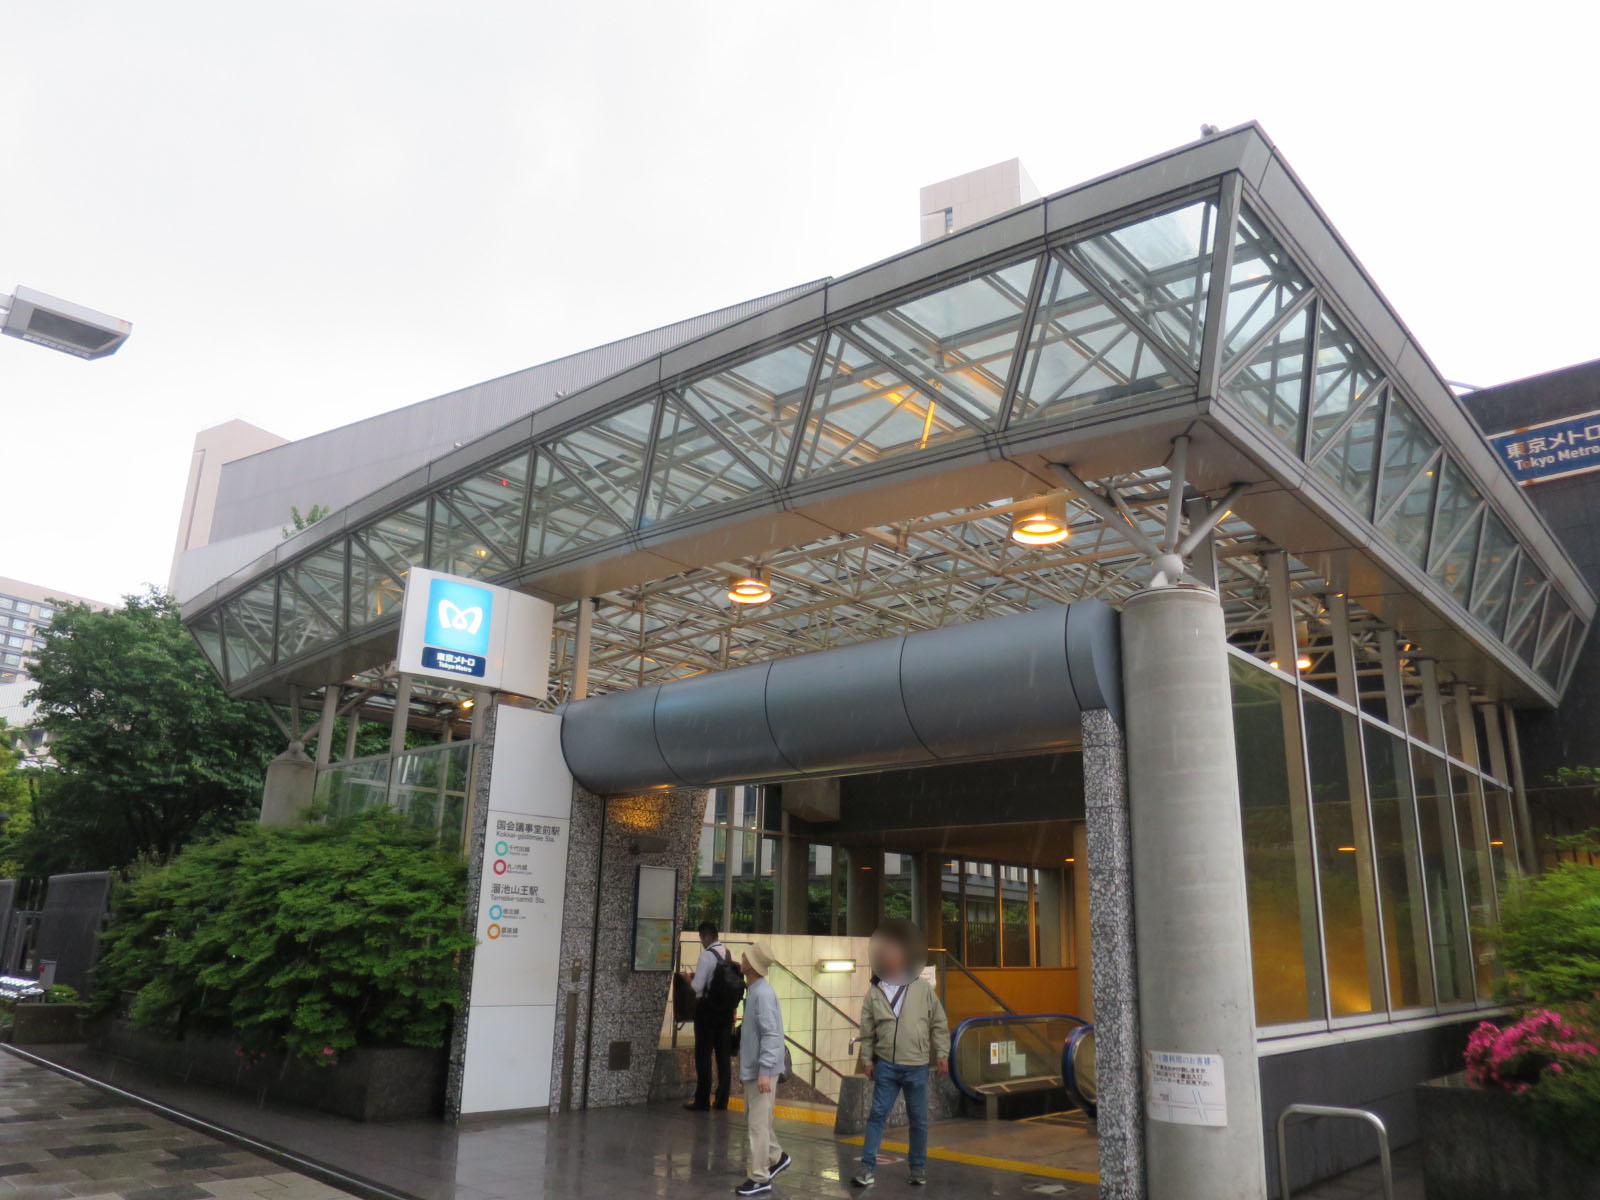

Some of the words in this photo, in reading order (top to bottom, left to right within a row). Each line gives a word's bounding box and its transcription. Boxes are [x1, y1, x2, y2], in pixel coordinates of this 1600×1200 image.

[1505, 425, 1600, 459] 東京メトロ
[1514, 455, 1555, 471] Tokyo
[1557, 445, 1600, 461] Metro
[436, 652, 476, 667] 東京メトロ
[438, 661, 455, 670] Tokyo
[455, 664, 472, 673] Metro
[496, 820, 560, 836] 国会議事堂前駅
[491, 883, 539, 896] 溜池山王駅
